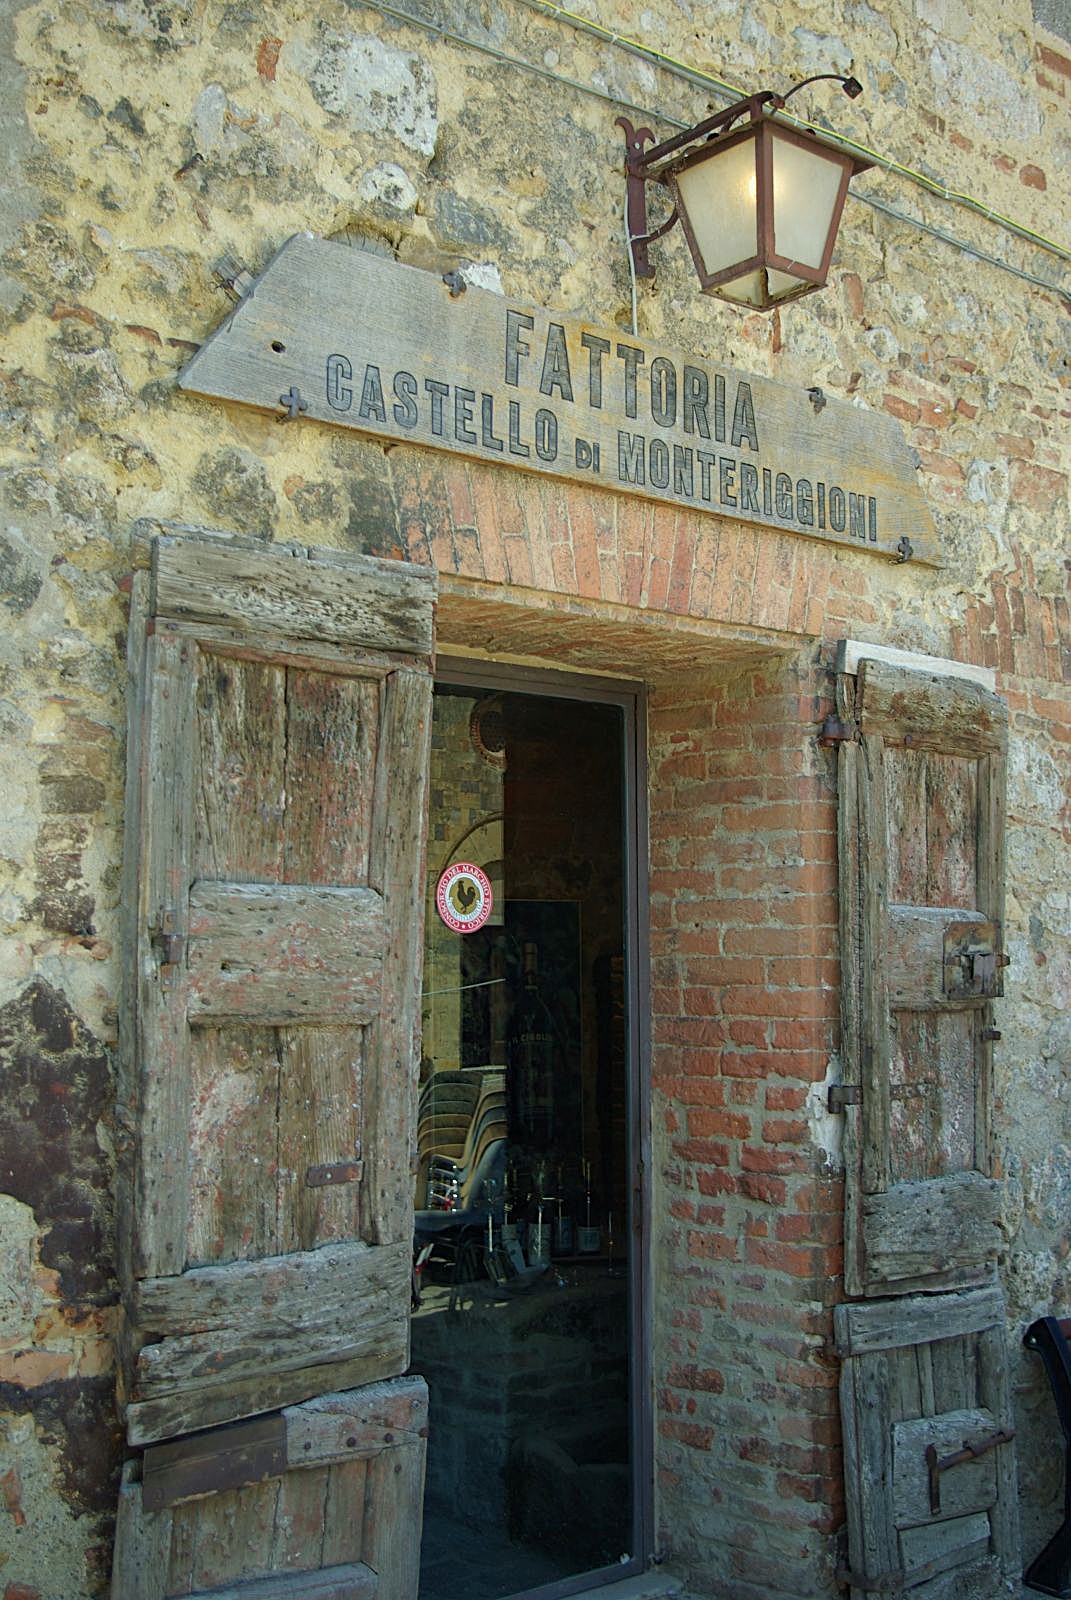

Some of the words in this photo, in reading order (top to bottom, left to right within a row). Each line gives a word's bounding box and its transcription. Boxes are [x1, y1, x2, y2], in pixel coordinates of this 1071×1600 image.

[326, 353, 558, 461] CASTELLO
[575, 437, 600, 473] DI
[617, 430, 877, 541] MONTERIGGIONI
[505, 309, 759, 451] FATTORIA
[447, 865, 461, 879] DEL
[462, 865, 489, 896] MARCHIO
